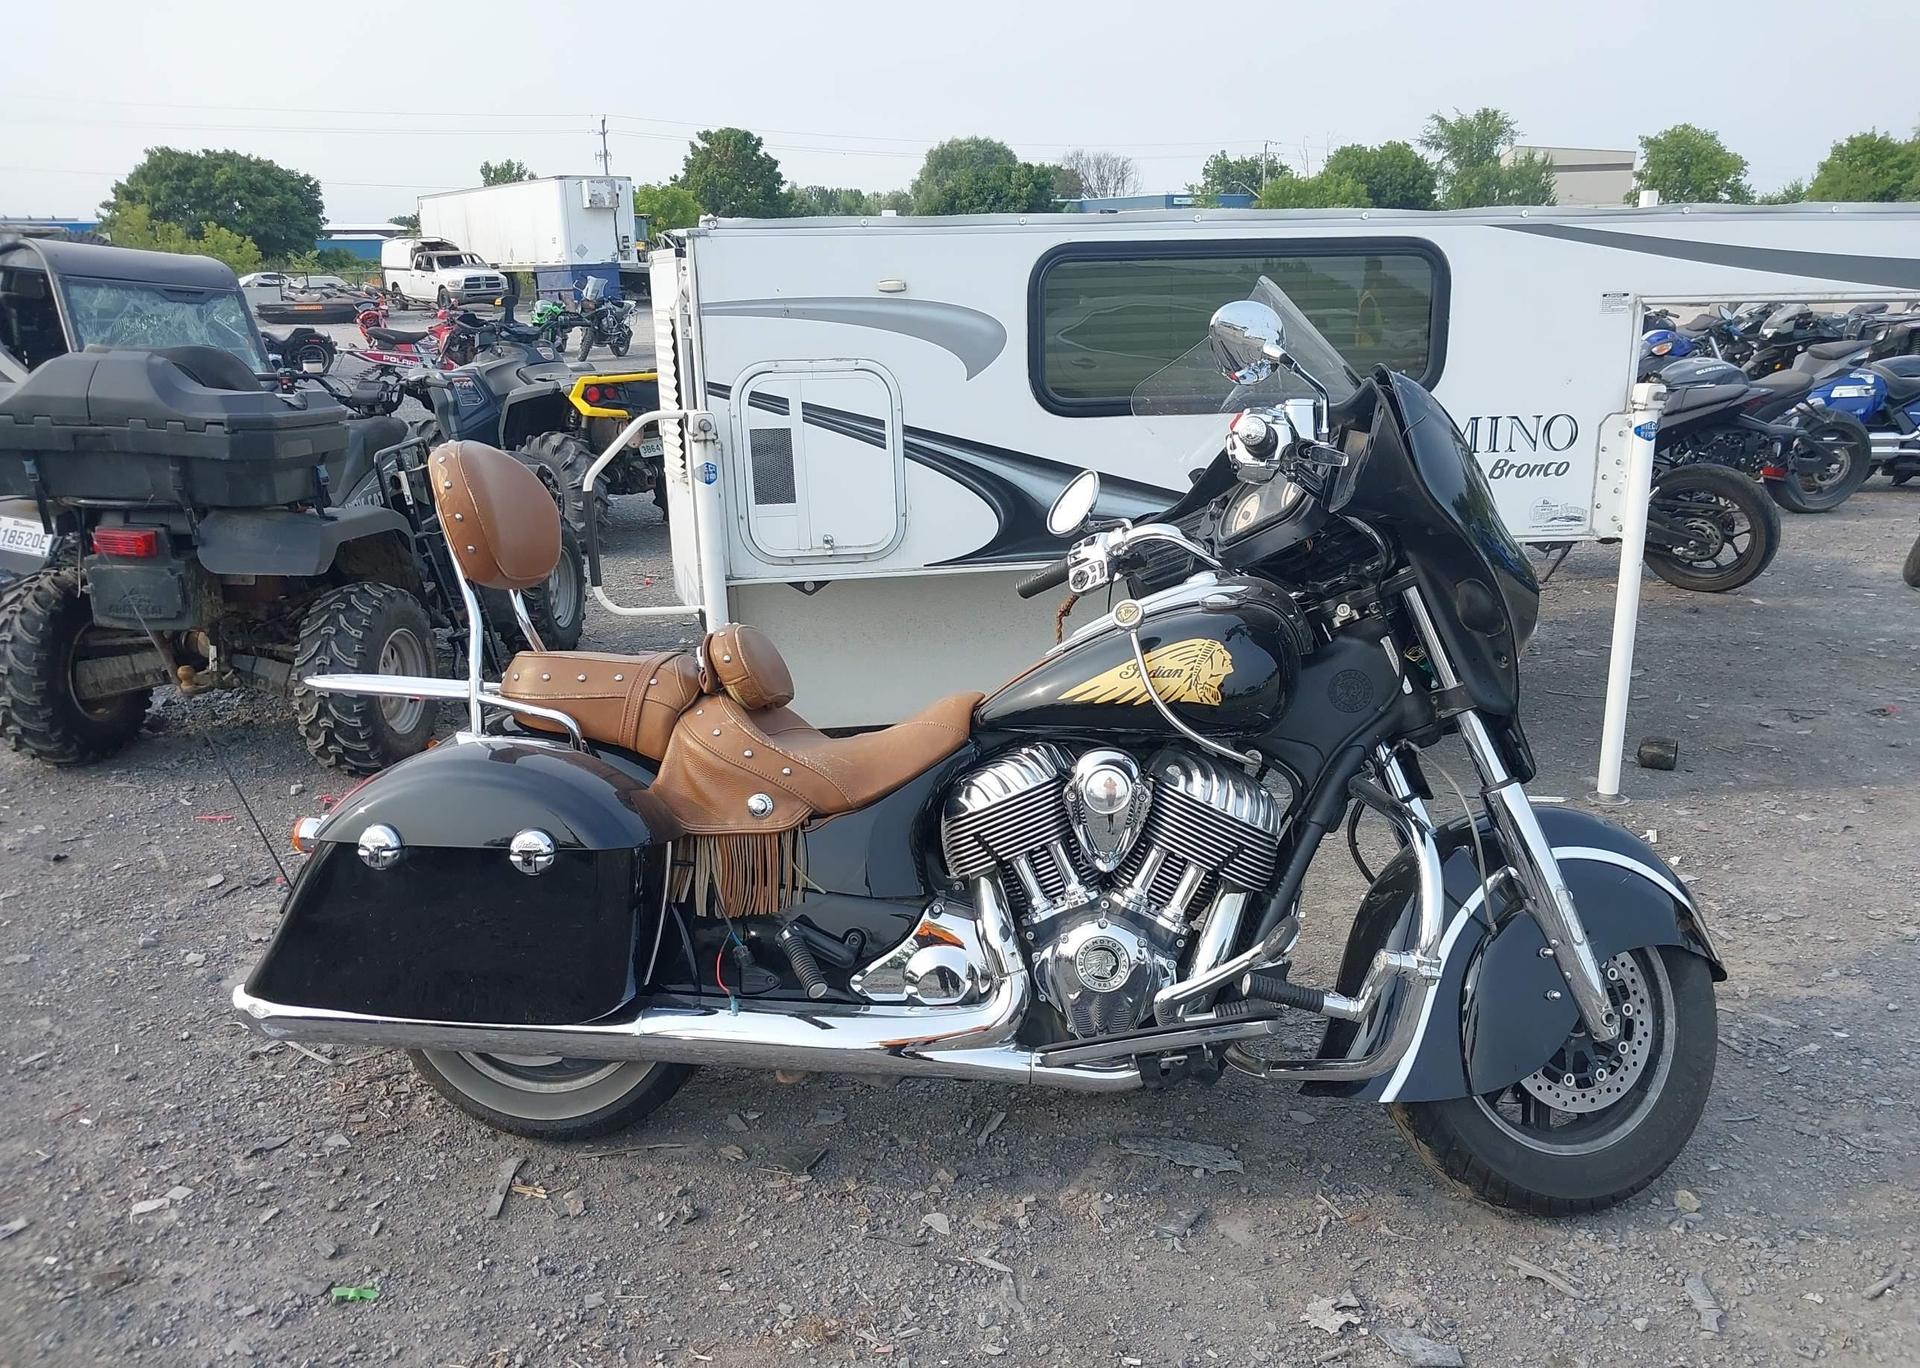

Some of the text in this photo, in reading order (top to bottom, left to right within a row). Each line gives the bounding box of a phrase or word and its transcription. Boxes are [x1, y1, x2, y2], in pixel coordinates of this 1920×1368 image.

[1696, 365, 1728, 375] SUZUKI
[1488, 458, 1571, 480] Bronco
[1119, 664, 1185, 680] Idian
[1091, 938, 1128, 982] MOTORCYCLE
